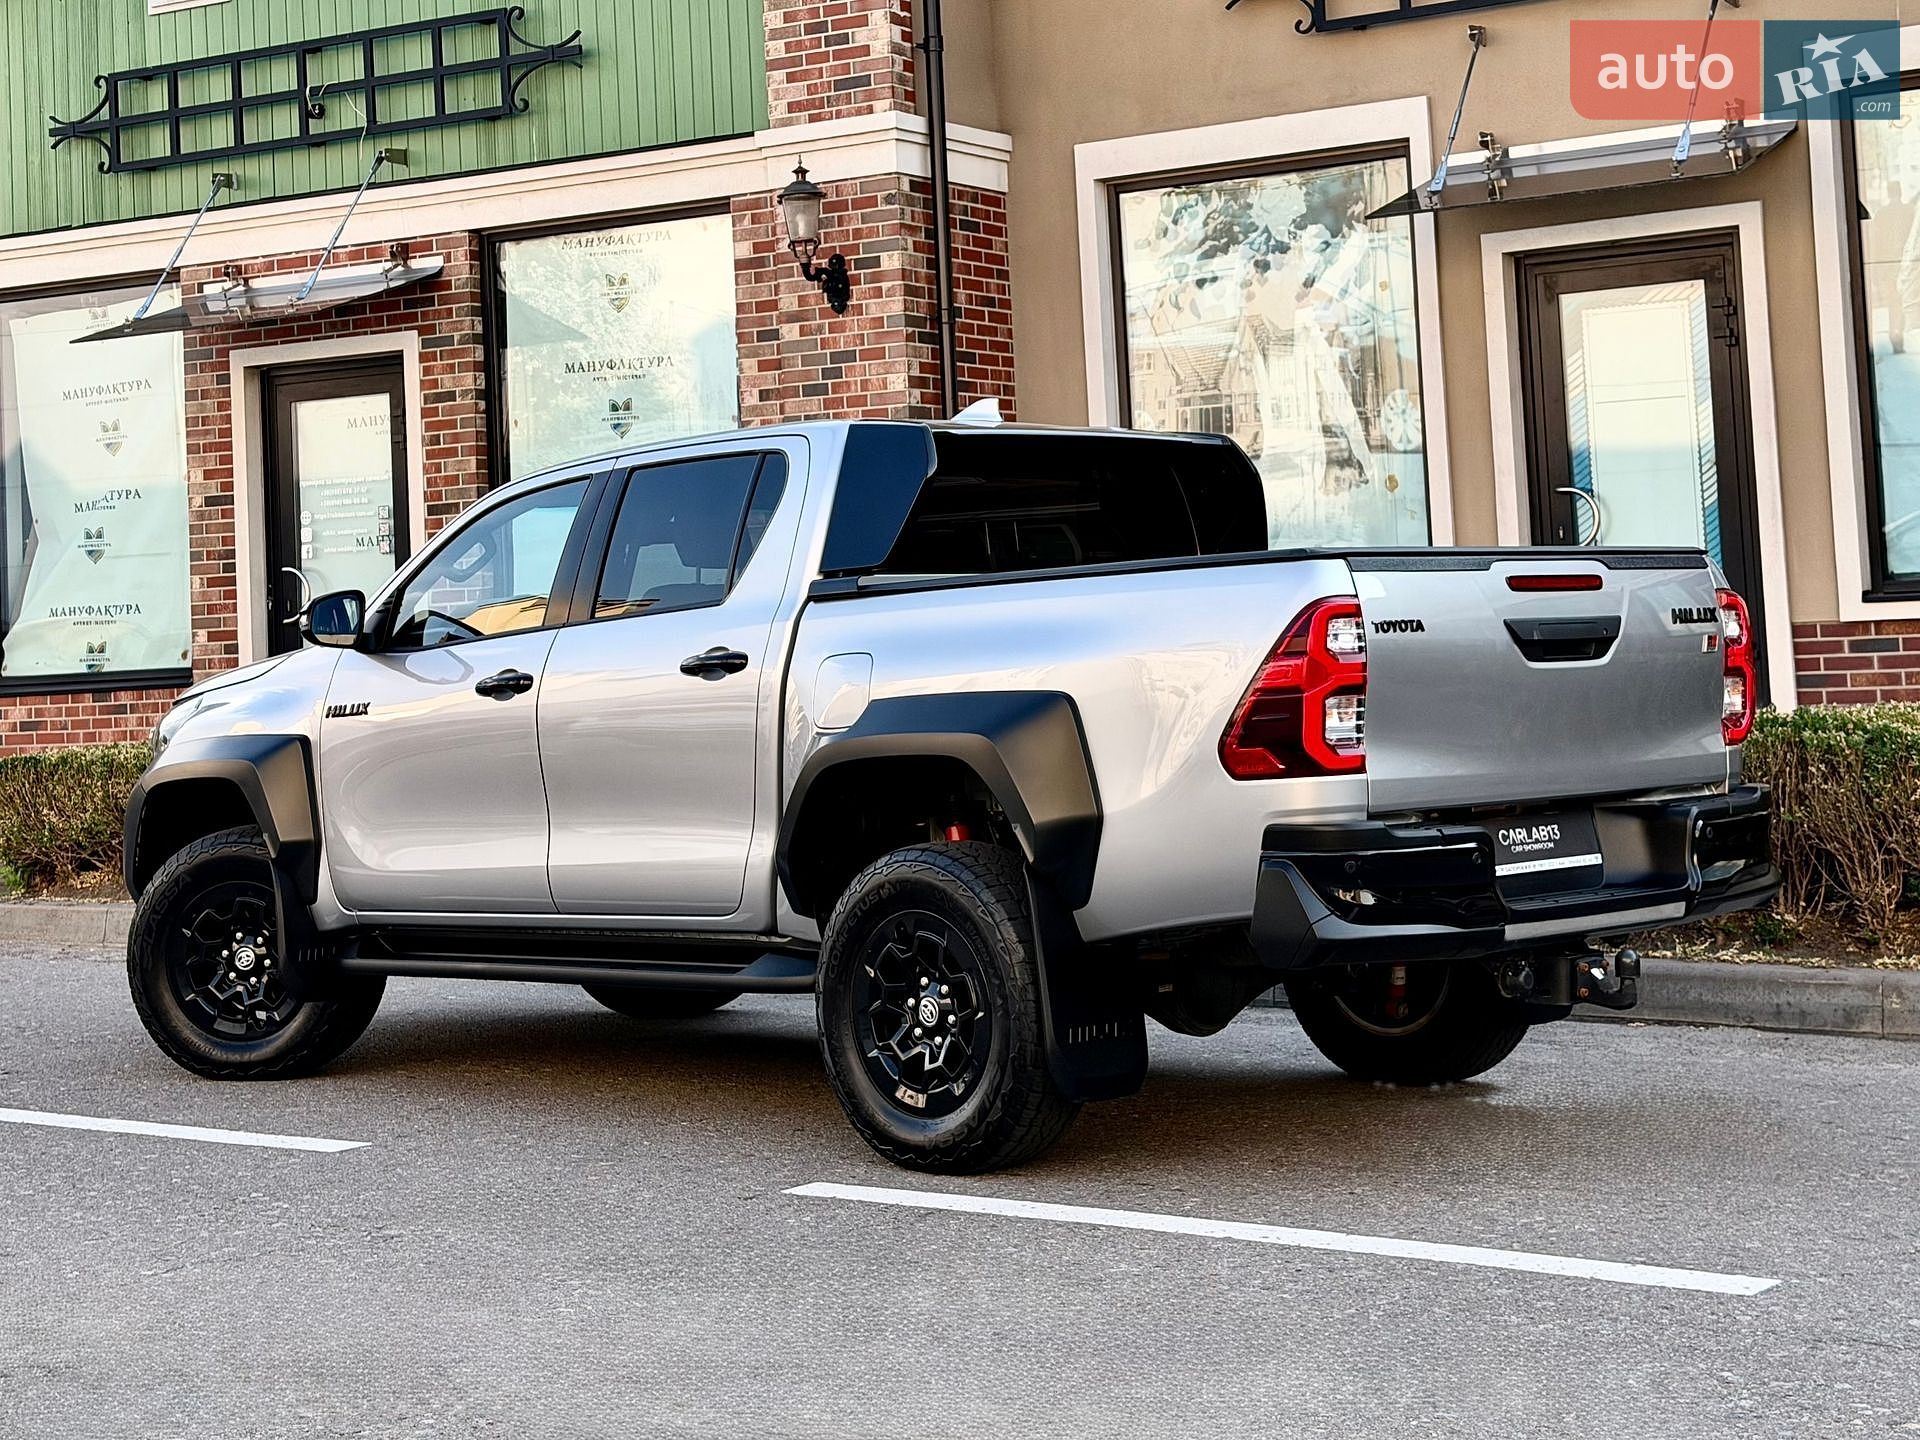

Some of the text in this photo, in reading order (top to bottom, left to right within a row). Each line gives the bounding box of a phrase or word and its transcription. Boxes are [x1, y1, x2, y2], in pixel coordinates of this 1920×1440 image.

[561, 230, 672, 250] МАНУФАКТУРА
[564, 356, 674, 374] МАНУФАКТУРА
[62, 378, 152, 401] МАНУФАКТУРА
[347, 414, 390, 429] МАНУ
[49, 604, 142, 618] МАНУФАКТУРА
[1671, 607, 1719, 625] HILUX
[1371, 619, 1426, 634] TOYOTA
[325, 702, 371, 719] HILUX
[1498, 824, 1560, 846] CARLAB13
[1511, 841, 1555, 853] CAR SHOWROOM
